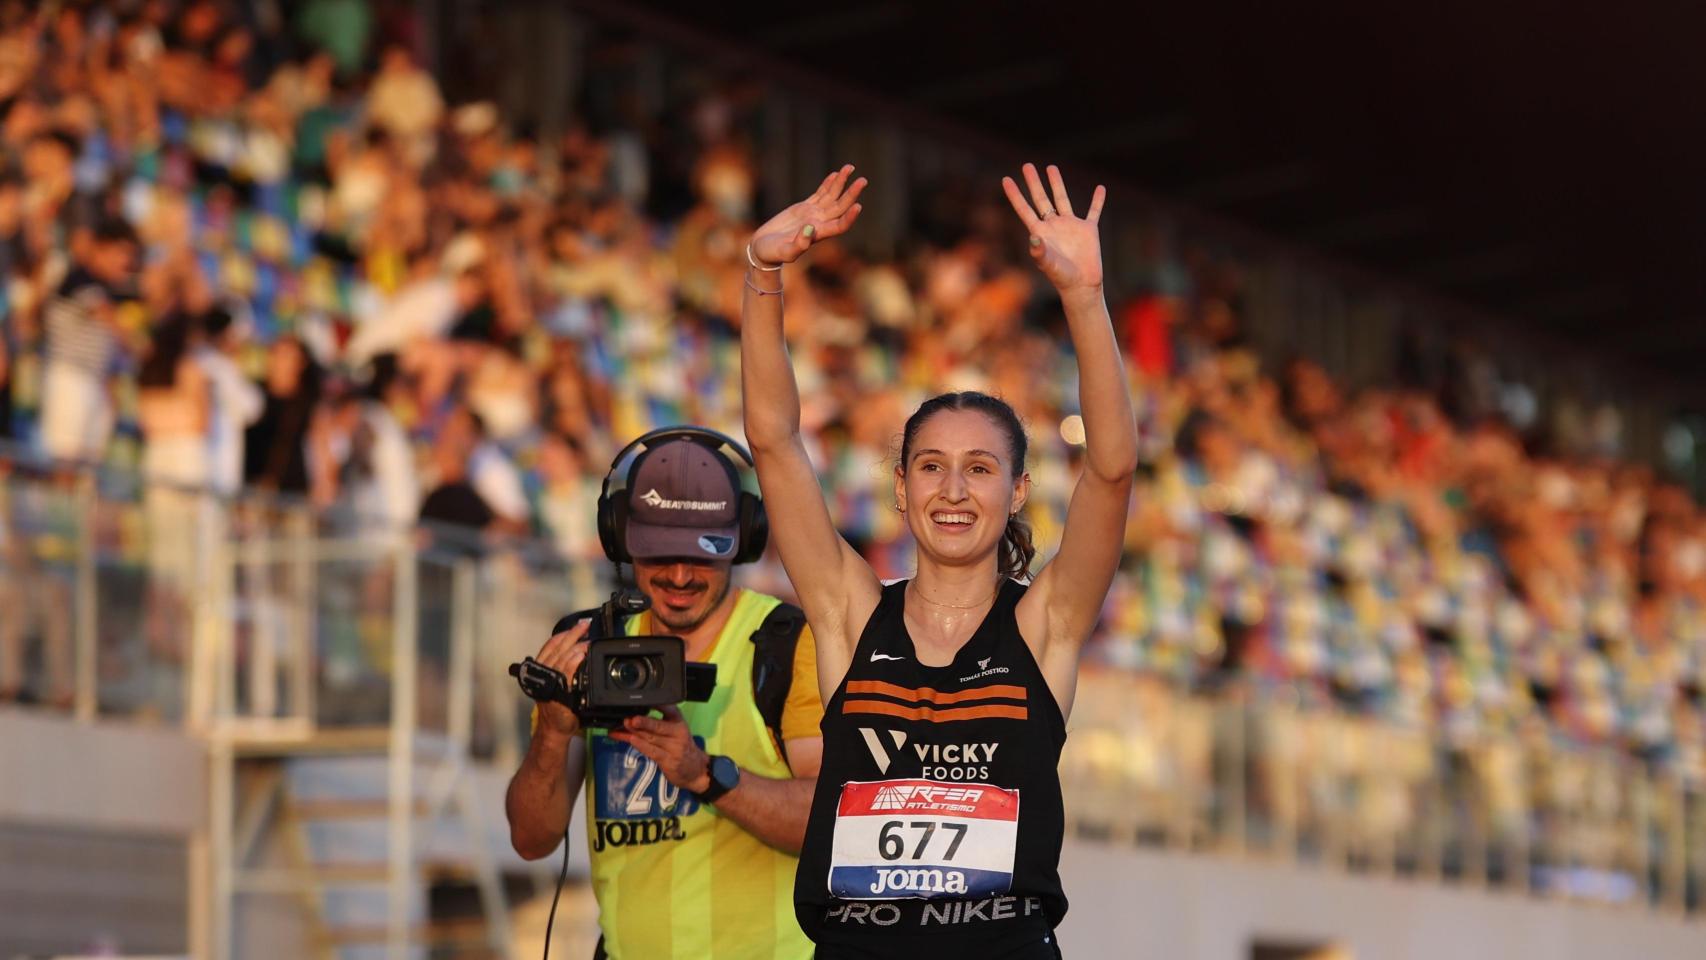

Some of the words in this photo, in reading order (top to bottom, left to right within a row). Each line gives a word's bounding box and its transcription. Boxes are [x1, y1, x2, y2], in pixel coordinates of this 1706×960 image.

[981, 667, 1010, 677] POSTIGO
[913, 743, 999, 763] VICKY
[922, 766, 989, 780] FOODS
[911, 786, 984, 803] RFEA
[905, 802, 976, 813] ATLETISMO
[878, 820, 968, 861] 677
[920, 896, 1016, 926] NIKE
